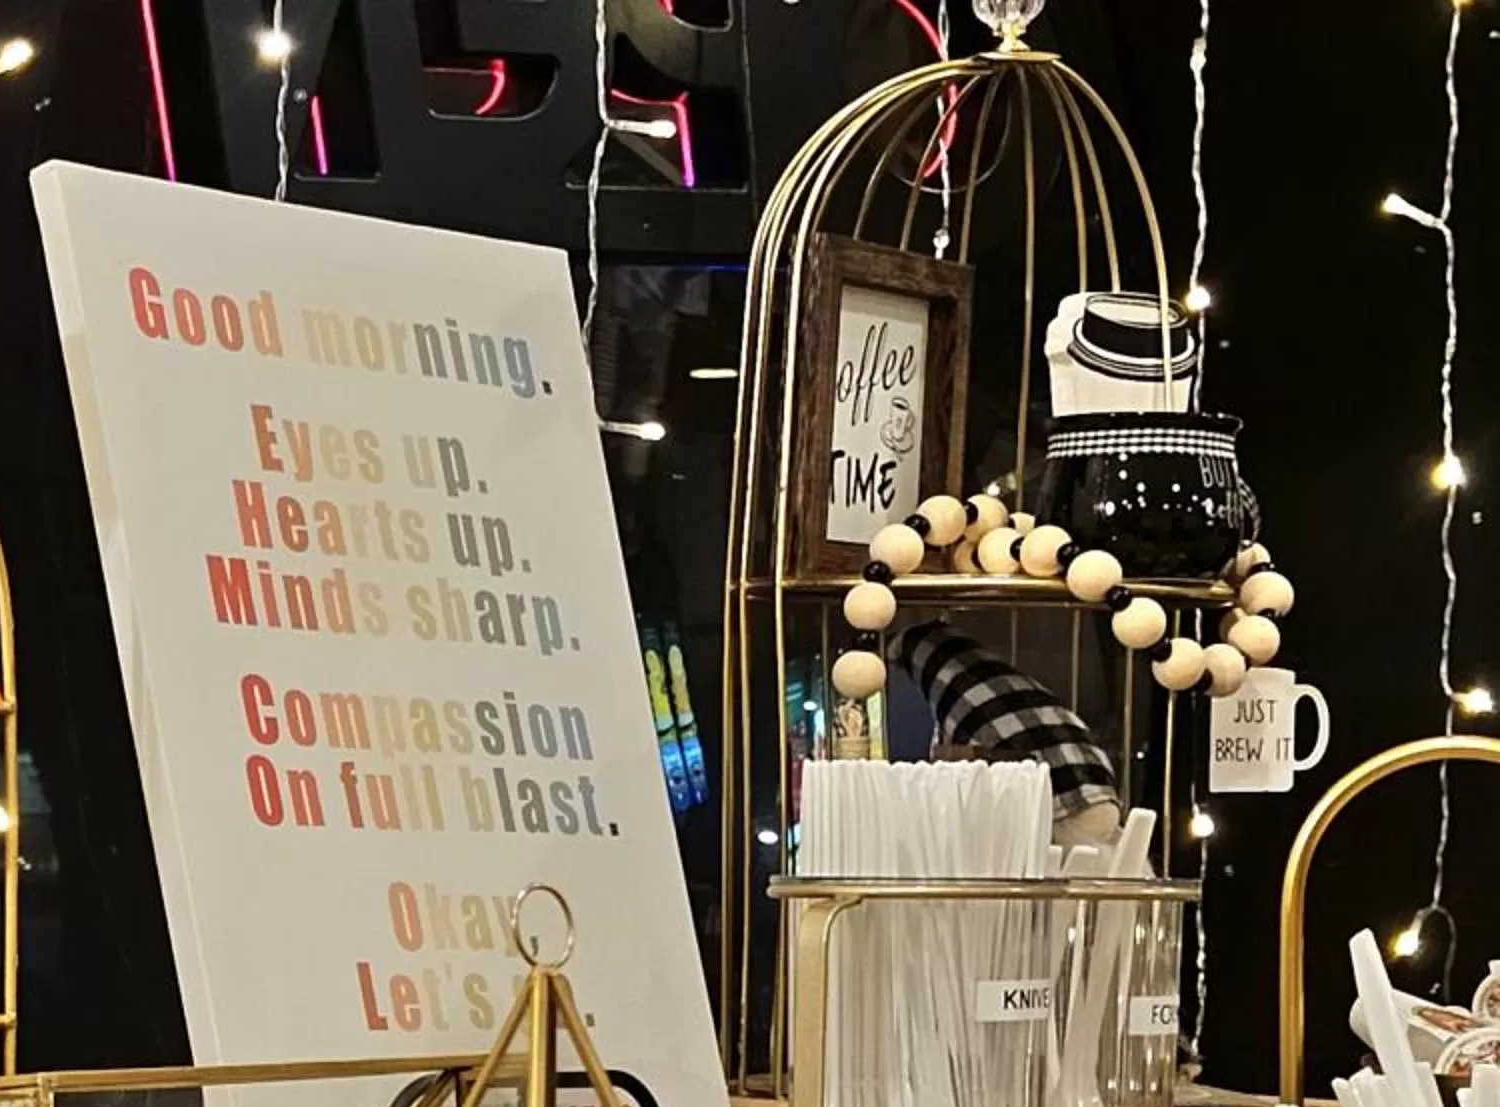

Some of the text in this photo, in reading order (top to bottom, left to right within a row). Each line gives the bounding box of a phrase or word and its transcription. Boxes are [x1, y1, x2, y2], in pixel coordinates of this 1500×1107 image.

[127, 265, 553, 398] Good morning.
[249, 402, 489, 497] Eyes up.
[830, 450, 898, 514] TIME
[231, 478, 533, 576] Hearts up.
[205, 554, 581, 657] Minds sharp.
[239, 673, 595, 762] Compassion
[1215, 737, 1292, 762] BREW IT
[1232, 698, 1277, 724] JUST
[245, 754, 620, 836] On full blast.
[387, 881, 540, 958] Okay,
[356, 960, 496, 1033] Let's
